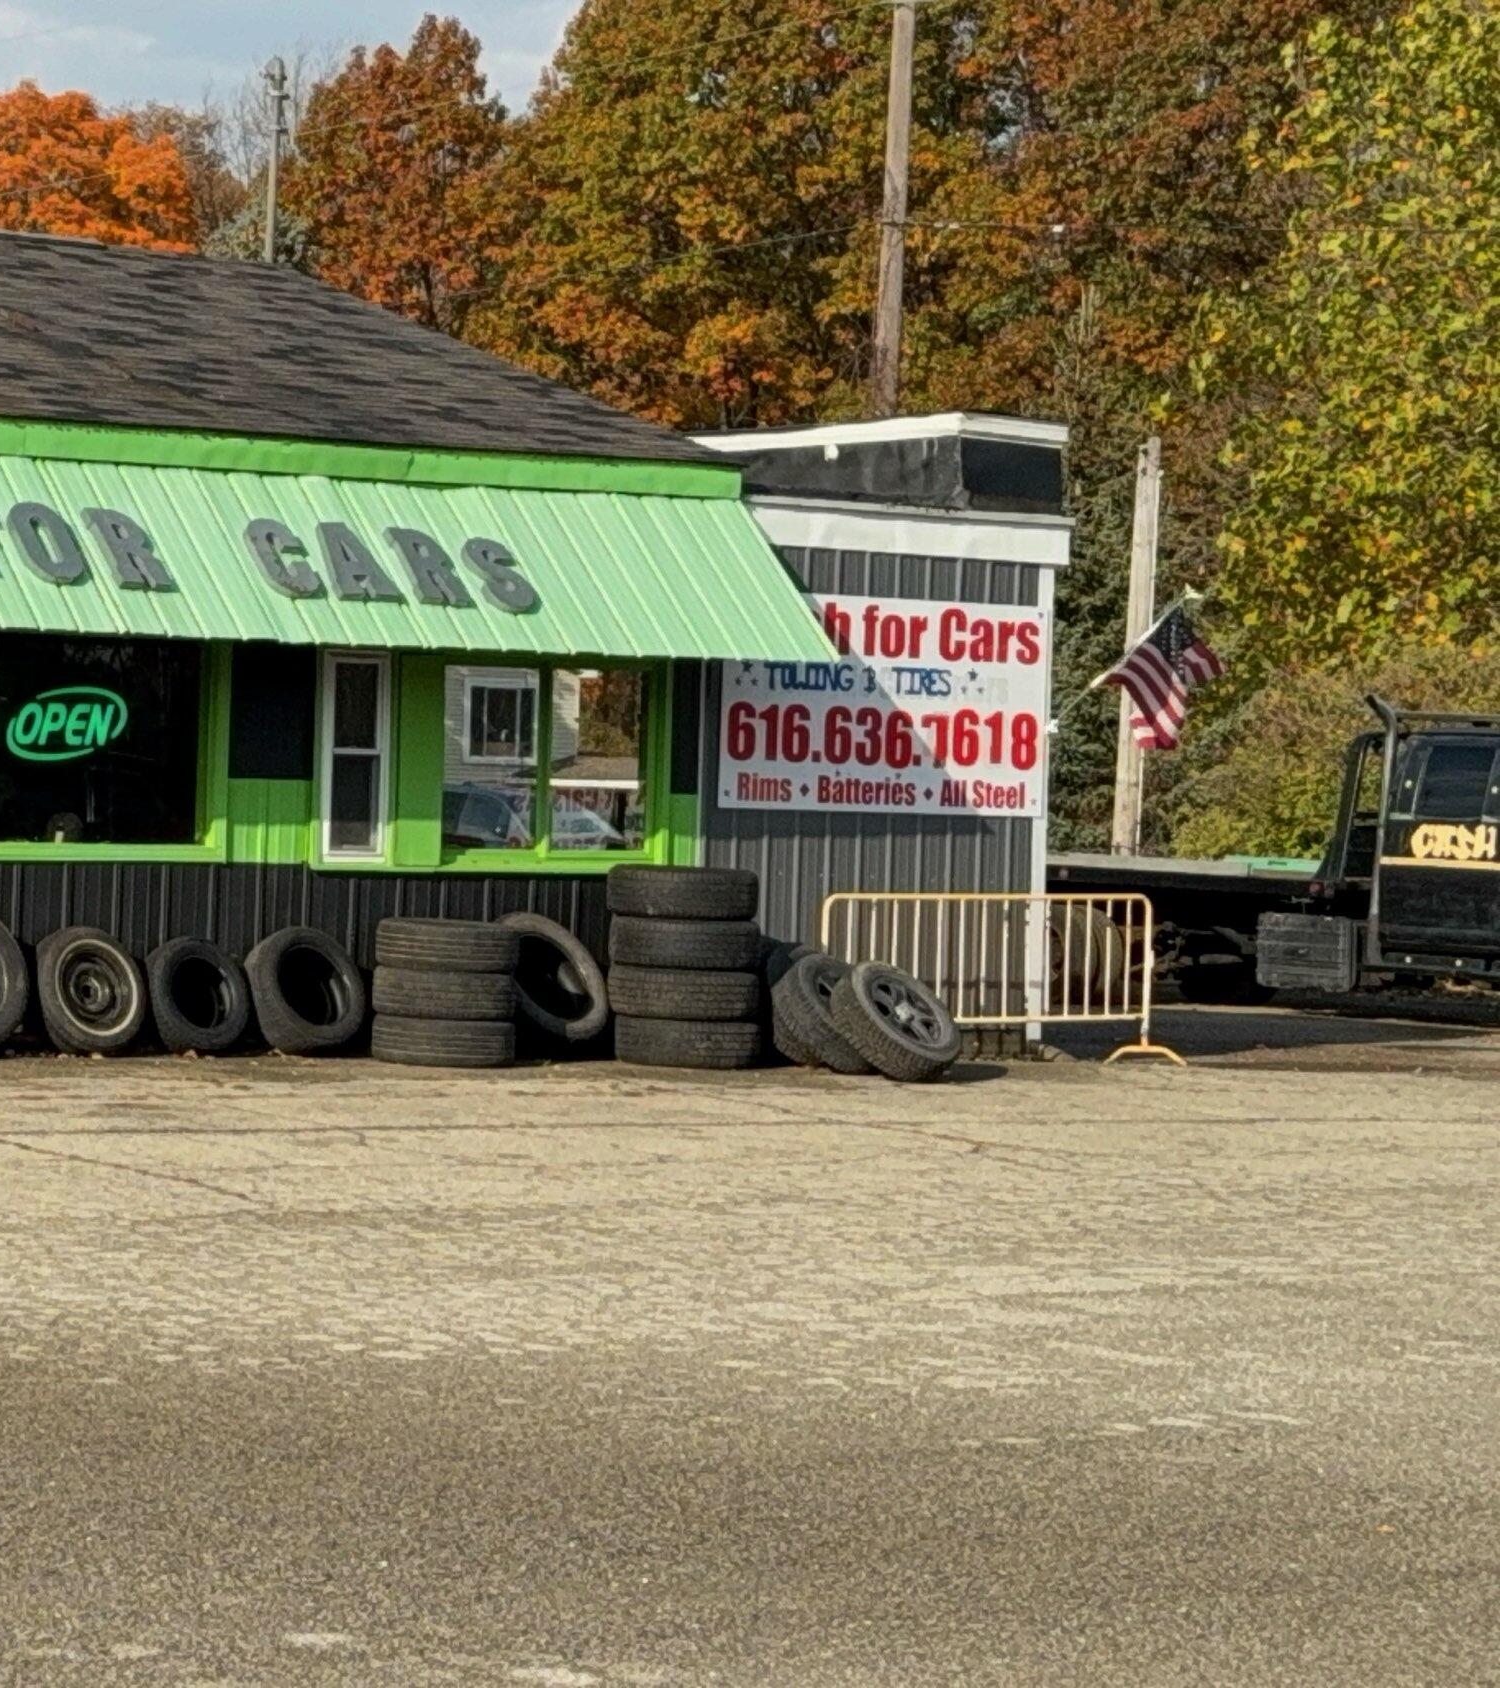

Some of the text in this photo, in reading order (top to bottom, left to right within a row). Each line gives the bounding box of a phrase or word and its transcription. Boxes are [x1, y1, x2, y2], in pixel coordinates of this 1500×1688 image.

[243, 517, 541, 614] CARS
[862, 604, 928, 659] for
[939, 607, 1040, 665] Cars
[764, 661, 854, 692] TOWING
[891, 666, 952, 696] TIRES
[13, 702, 115, 747] OPEN
[726, 700, 1038, 770] 616.636.7618
[736, 772, 1026, 810] Rims Batteries All Steel
[1411, 823, 1497, 860] CASH
